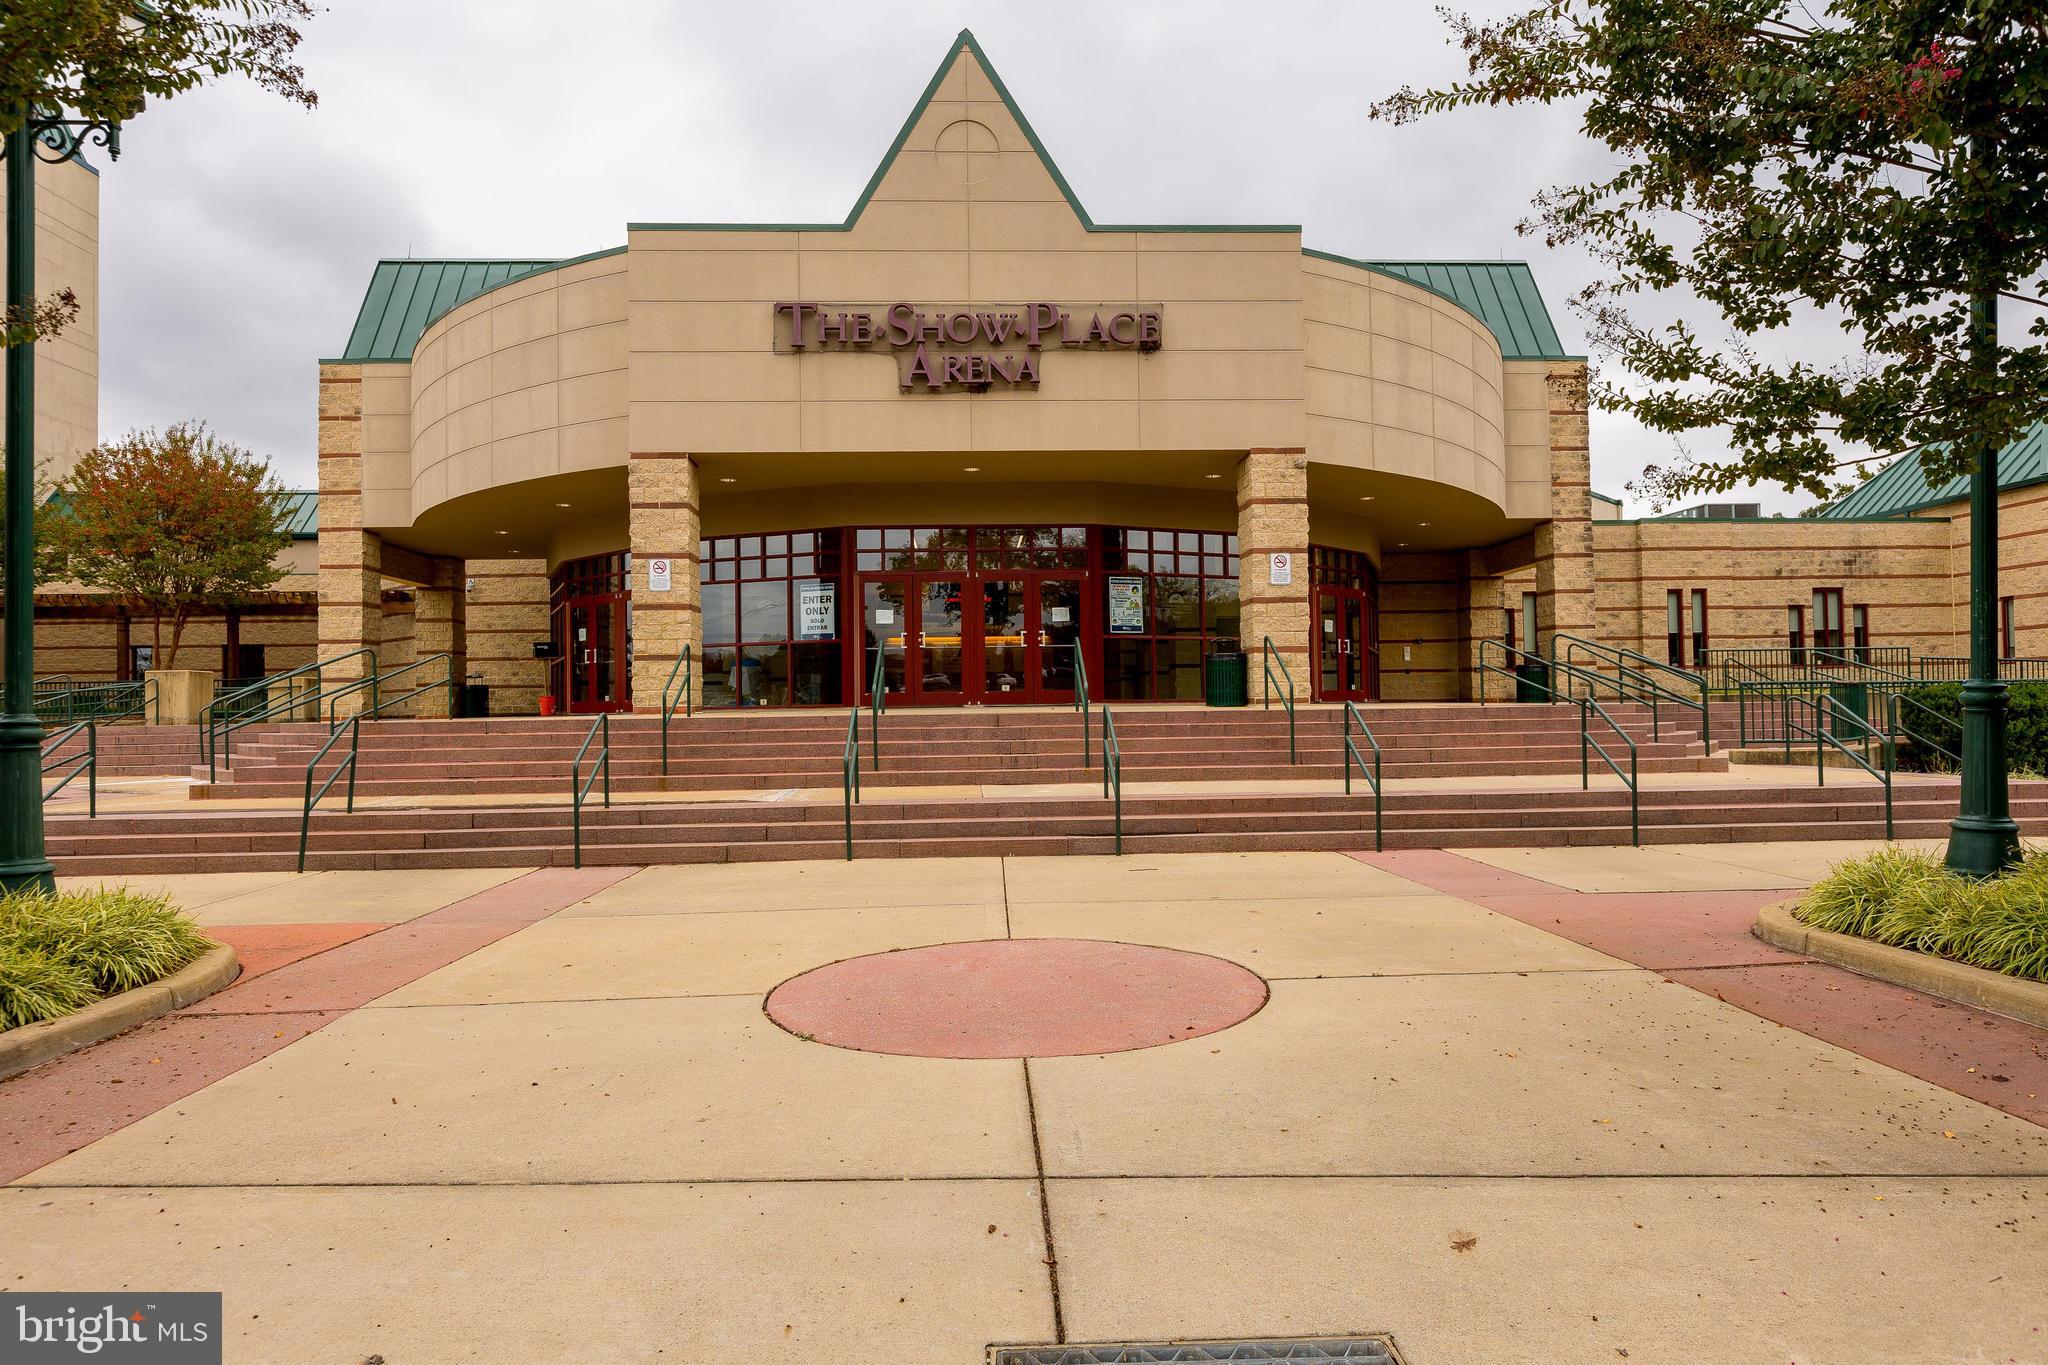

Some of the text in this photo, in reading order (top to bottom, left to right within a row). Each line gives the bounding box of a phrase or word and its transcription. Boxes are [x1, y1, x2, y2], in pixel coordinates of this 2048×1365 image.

[901, 344, 1040, 388] ARENA
[802, 596, 832, 604] ENTER
[806, 606, 829, 615] ONLY
